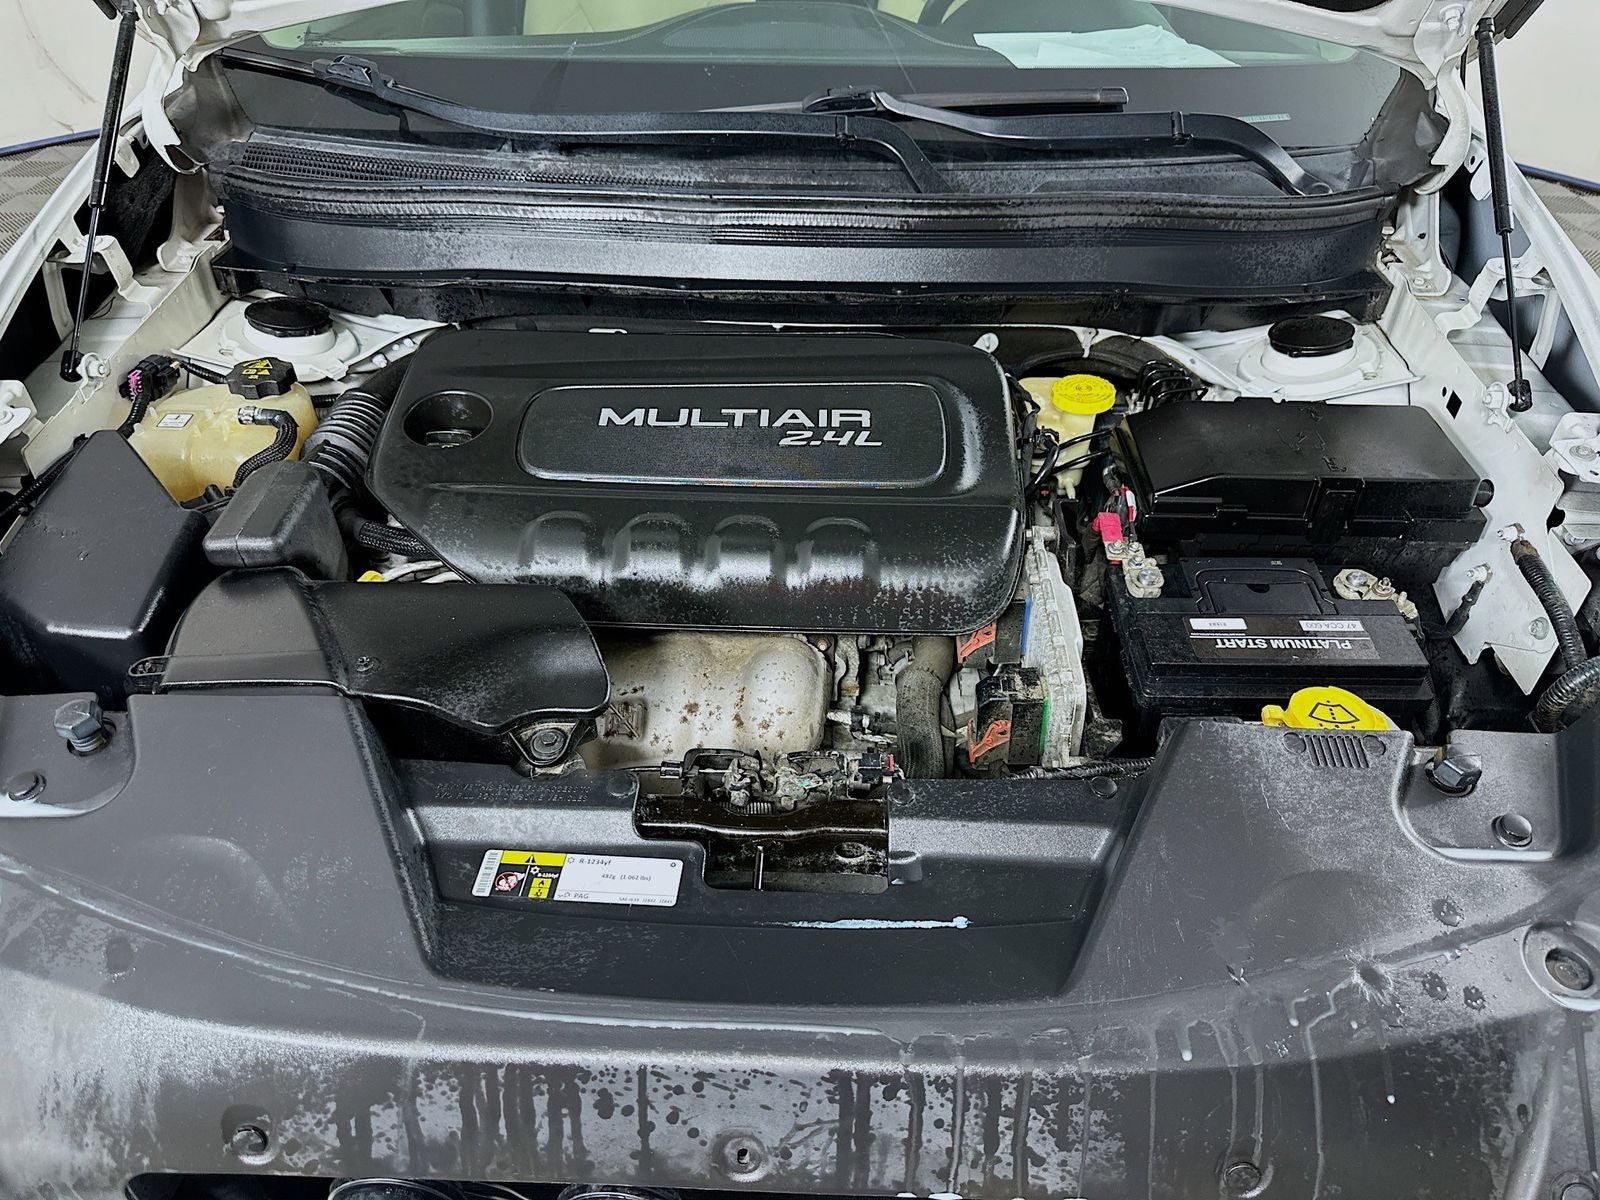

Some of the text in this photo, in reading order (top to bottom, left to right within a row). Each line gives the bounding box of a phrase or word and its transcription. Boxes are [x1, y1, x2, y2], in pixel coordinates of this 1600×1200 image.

[598, 407, 871, 428] MULTIAIR
[778, 430, 883, 446] 2.4L
[1324, 622, 1344, 630] CCA
[1215, 638, 1352, 649] PLATINUM START
[579, 859, 612, 867] R-1234yf
